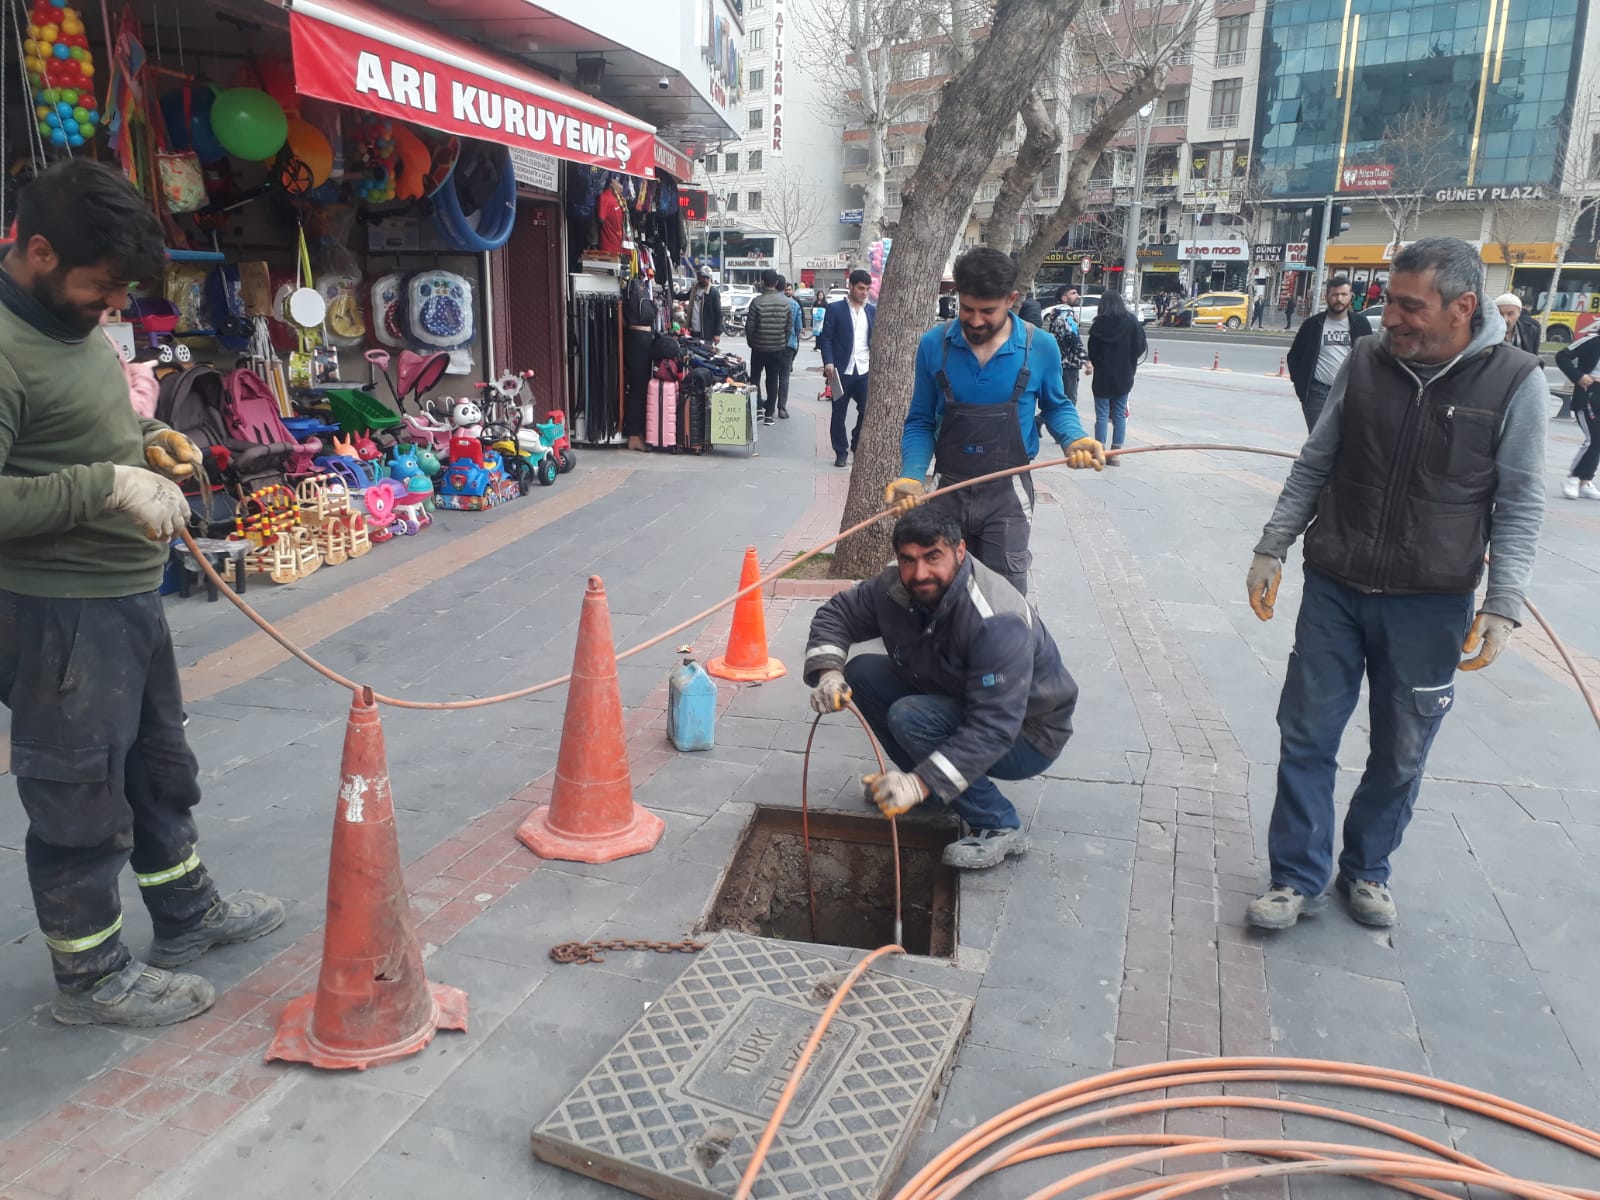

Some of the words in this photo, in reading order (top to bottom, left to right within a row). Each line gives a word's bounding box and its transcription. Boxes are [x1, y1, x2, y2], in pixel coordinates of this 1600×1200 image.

[774, 12, 784, 96] ATLIHAN
[355, 50, 437, 113] ARI
[451, 80, 632, 169] KURUYEMİŞ
[773, 103, 783, 150] PARK
[1436, 187, 1487, 202] GÜNEY
[1491, 186, 1543, 200] PLAZA
[1255, 244, 1282, 254] GÜNEY
[1255, 254, 1280, 262] PLAZA
[718, 400, 724, 415] 3
